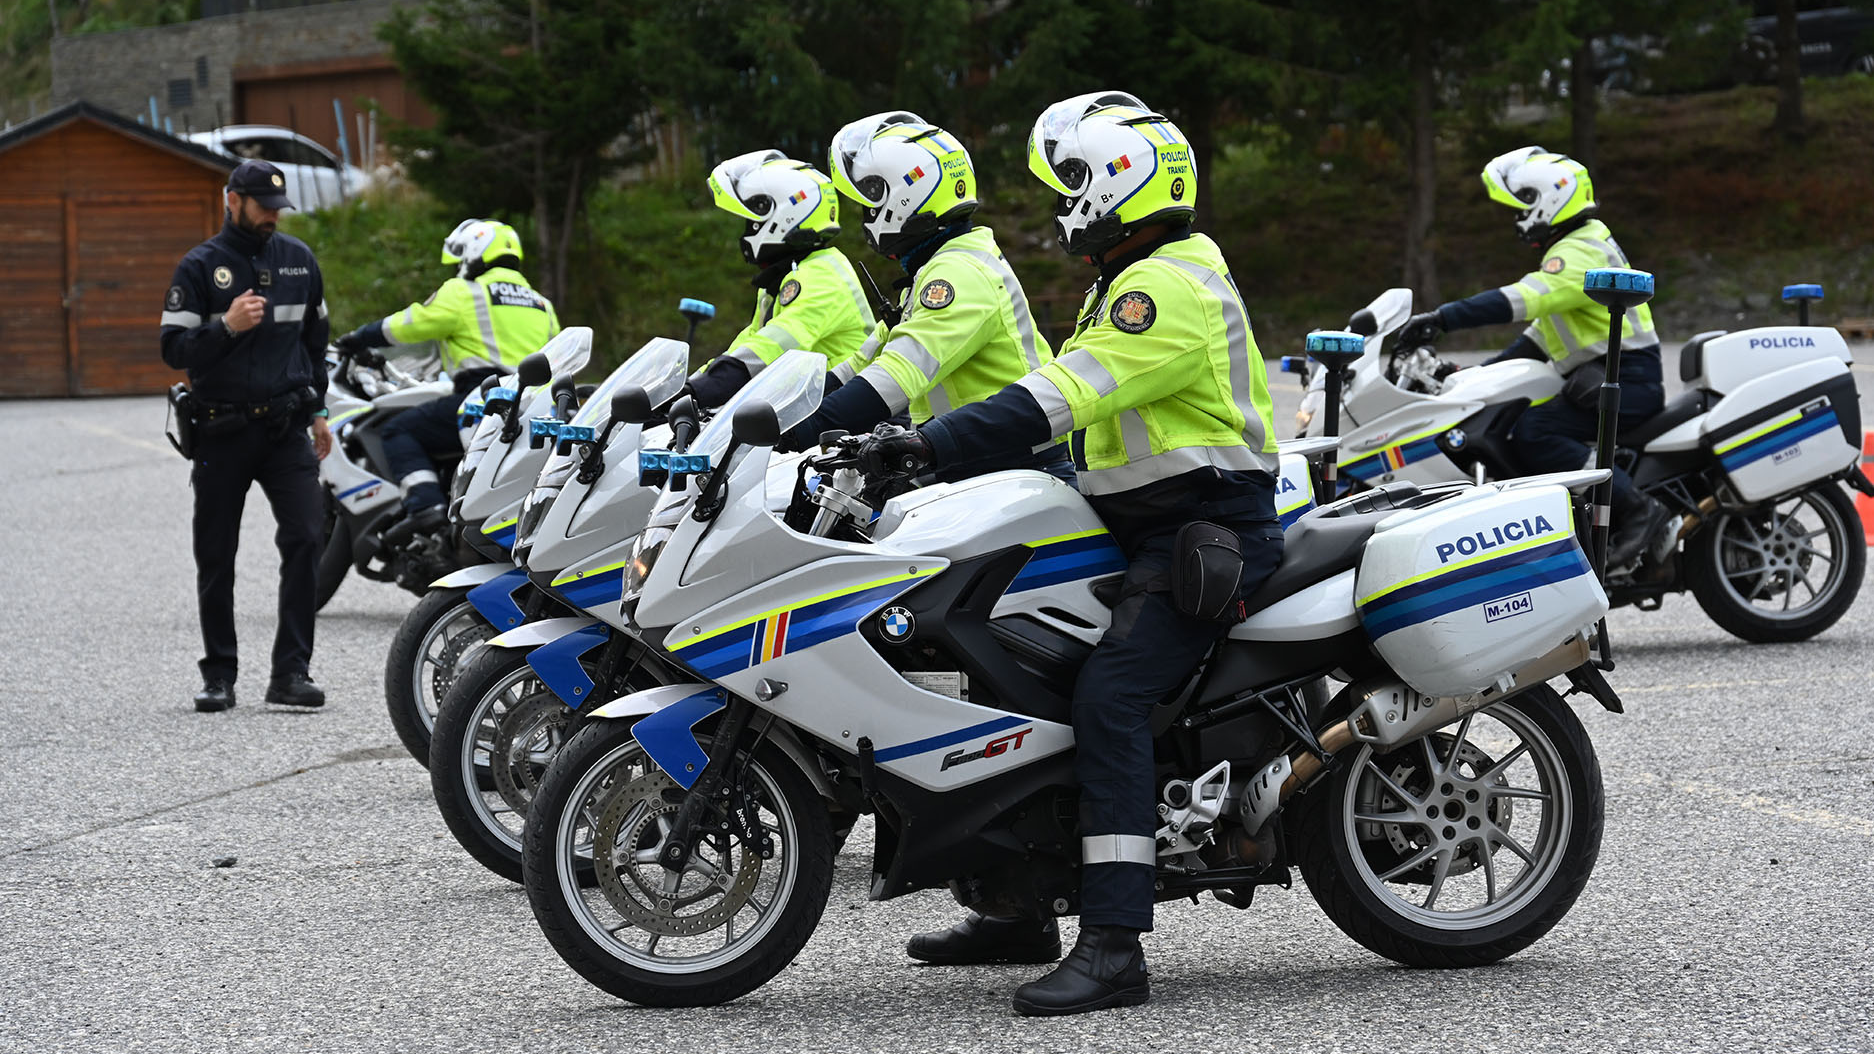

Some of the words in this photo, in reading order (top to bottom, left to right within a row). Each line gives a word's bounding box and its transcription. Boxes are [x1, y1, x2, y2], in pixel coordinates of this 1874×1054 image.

[1160, 150, 1188, 163] POLICIA
[943, 157, 966, 170] POLICIA
[1167, 165, 1188, 175] TRANSIT
[1101, 192, 1114, 204] B+
[1749, 336, 1816, 349] POLICIA
[1435, 515, 1554, 564] POLICIA
[881, 607, 911, 621] BMW
[1487, 597, 1529, 618] M-104
